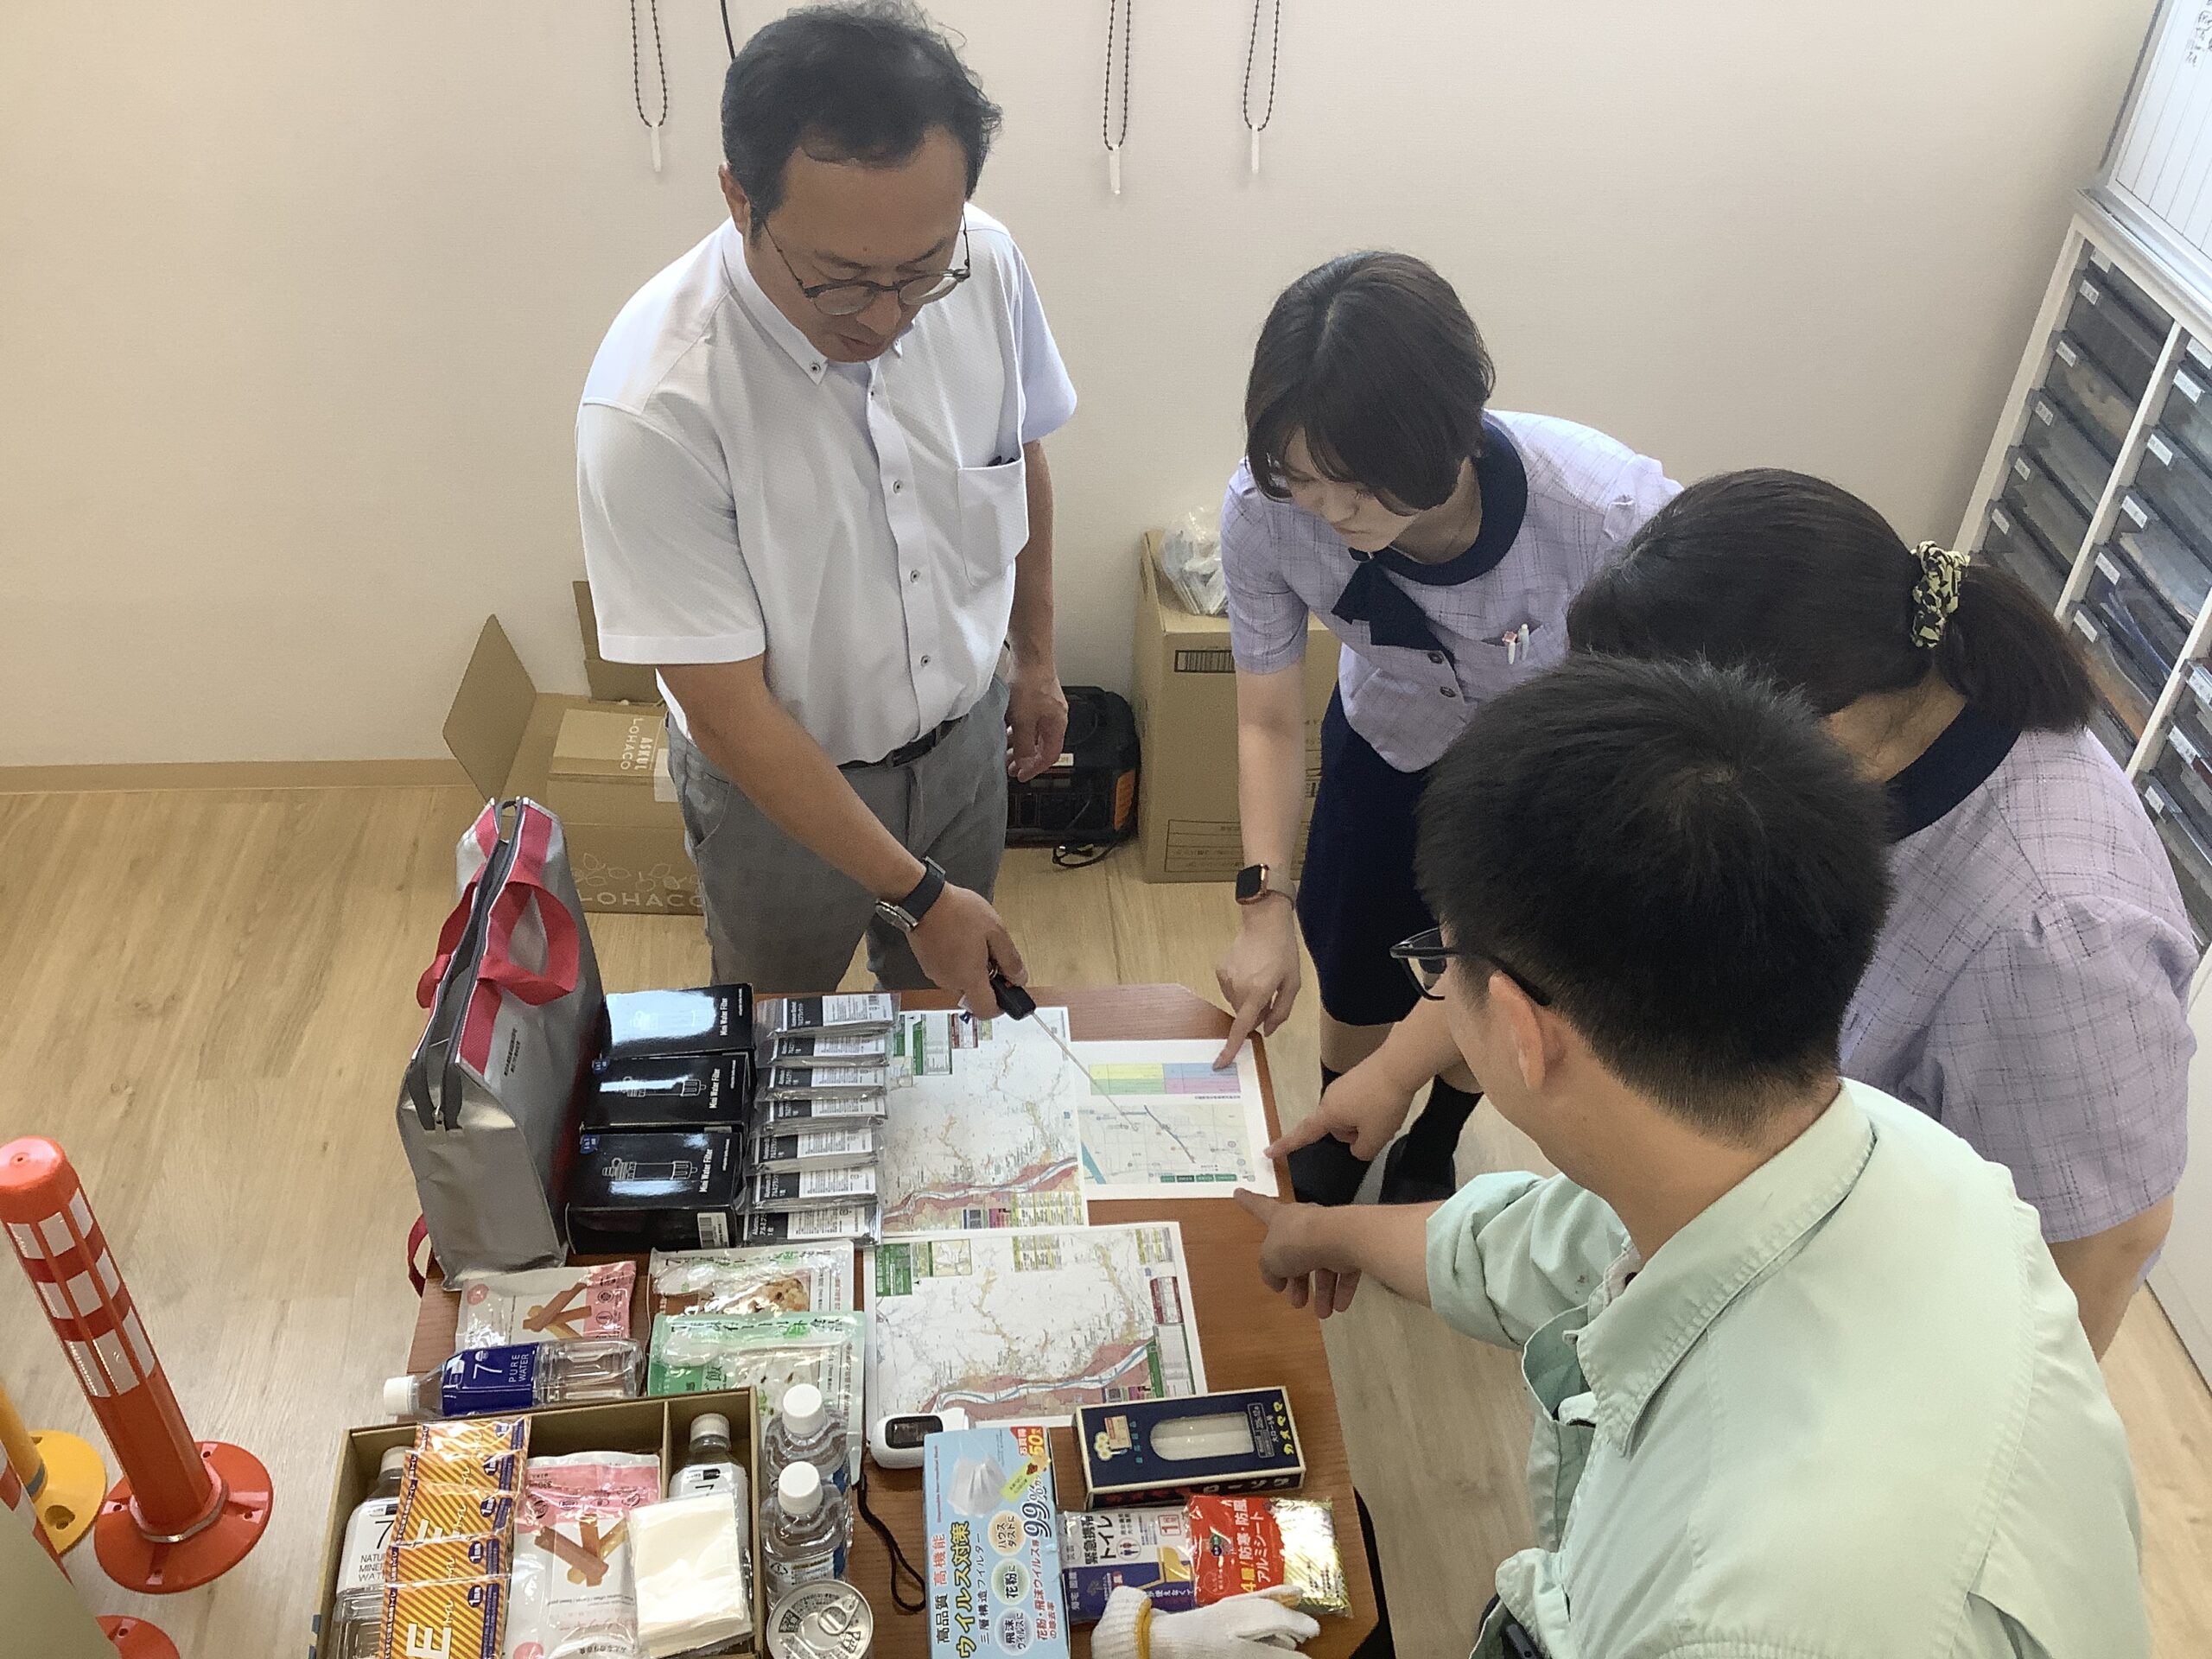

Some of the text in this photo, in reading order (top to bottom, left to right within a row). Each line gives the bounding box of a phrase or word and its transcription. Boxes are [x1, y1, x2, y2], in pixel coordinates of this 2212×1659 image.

[620, 718, 644, 770] LOHACO
[636, 738, 654, 771] ASKUL
[709, 1068, 721, 1109] Mini Water Filter
[698, 1148, 714, 1192] Mini Water Filter
[473, 1363, 503, 1379] 7
[509, 1354, 519, 1382] PURE
[518, 1354, 529, 1382] WATER
[1018, 1428, 1027, 1455] お買得
[1273, 1402, 1294, 1455] カメヤマ
[375, 1520, 394, 1549] 7
[998, 1522, 1007, 1548] ハウス
[1007, 1516, 1017, 1548] ダストに
[1081, 1516, 1098, 1565] 緊急携帯
[1098, 1516, 1116, 1558] トイレ
[1250, 1511, 1271, 1583] アルミシート
[360, 1554, 385, 1563] NATU
[932, 1534, 950, 1643] 高品質 高機能
[950, 1522, 976, 1658] ウイルス対策
[1004, 1565, 1019, 1599] 花粉に
[406, 1623, 452, 1658] E
[1004, 1619, 1016, 1643] 飛沫
[1015, 1612, 1027, 1649] ウイルスに
